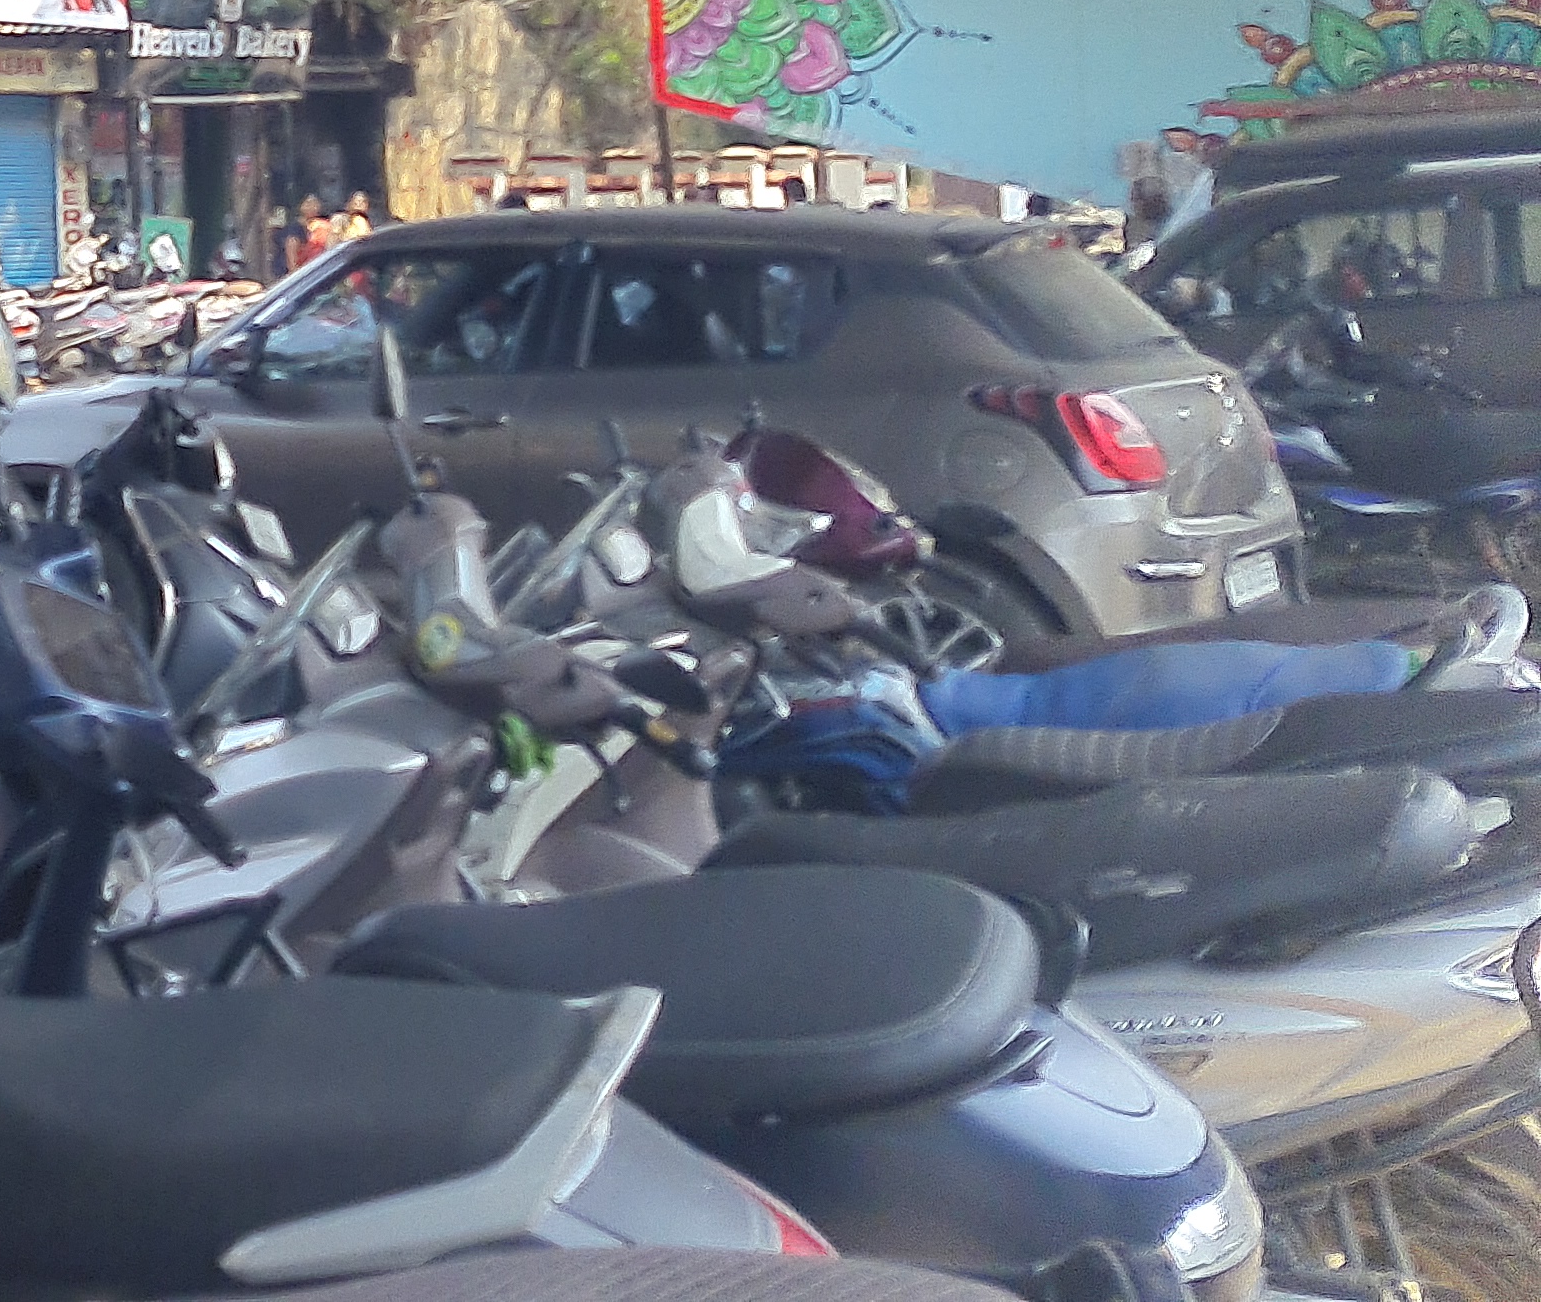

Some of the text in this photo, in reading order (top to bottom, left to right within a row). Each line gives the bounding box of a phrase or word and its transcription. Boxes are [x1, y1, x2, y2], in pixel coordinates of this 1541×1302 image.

[129, 17, 313, 67] Heaven's Bakery
[62, 165, 83, 245] XERO
